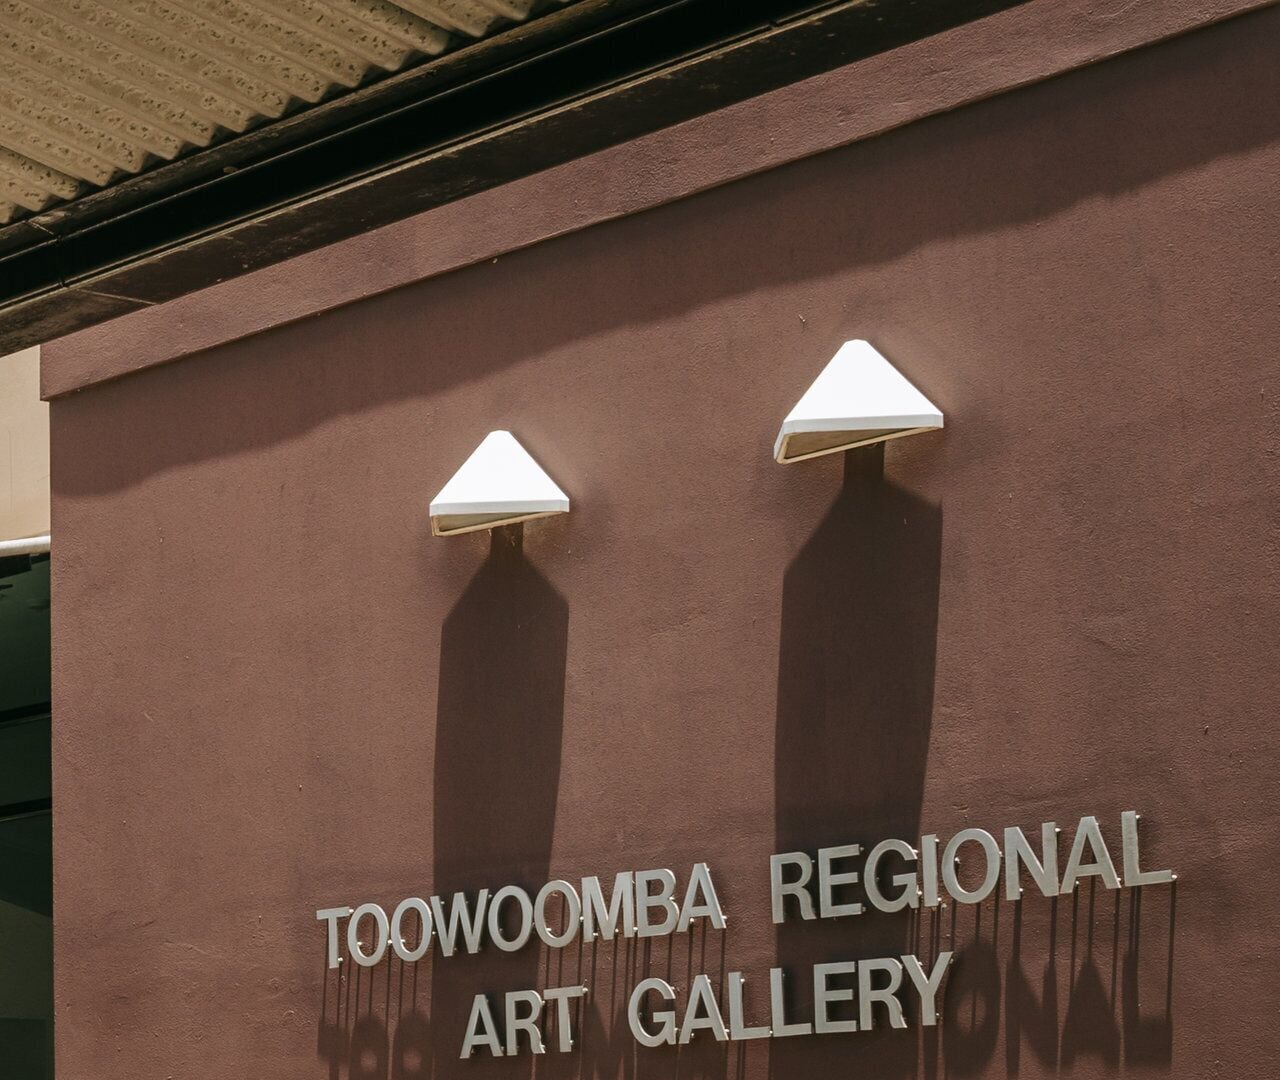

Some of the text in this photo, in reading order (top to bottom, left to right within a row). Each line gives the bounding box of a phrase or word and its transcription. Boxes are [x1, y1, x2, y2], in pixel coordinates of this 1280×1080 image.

[316, 810, 1177, 968] TOOWOOMBA REGIONAL
[460, 951, 954, 1058] ART GALLERY
